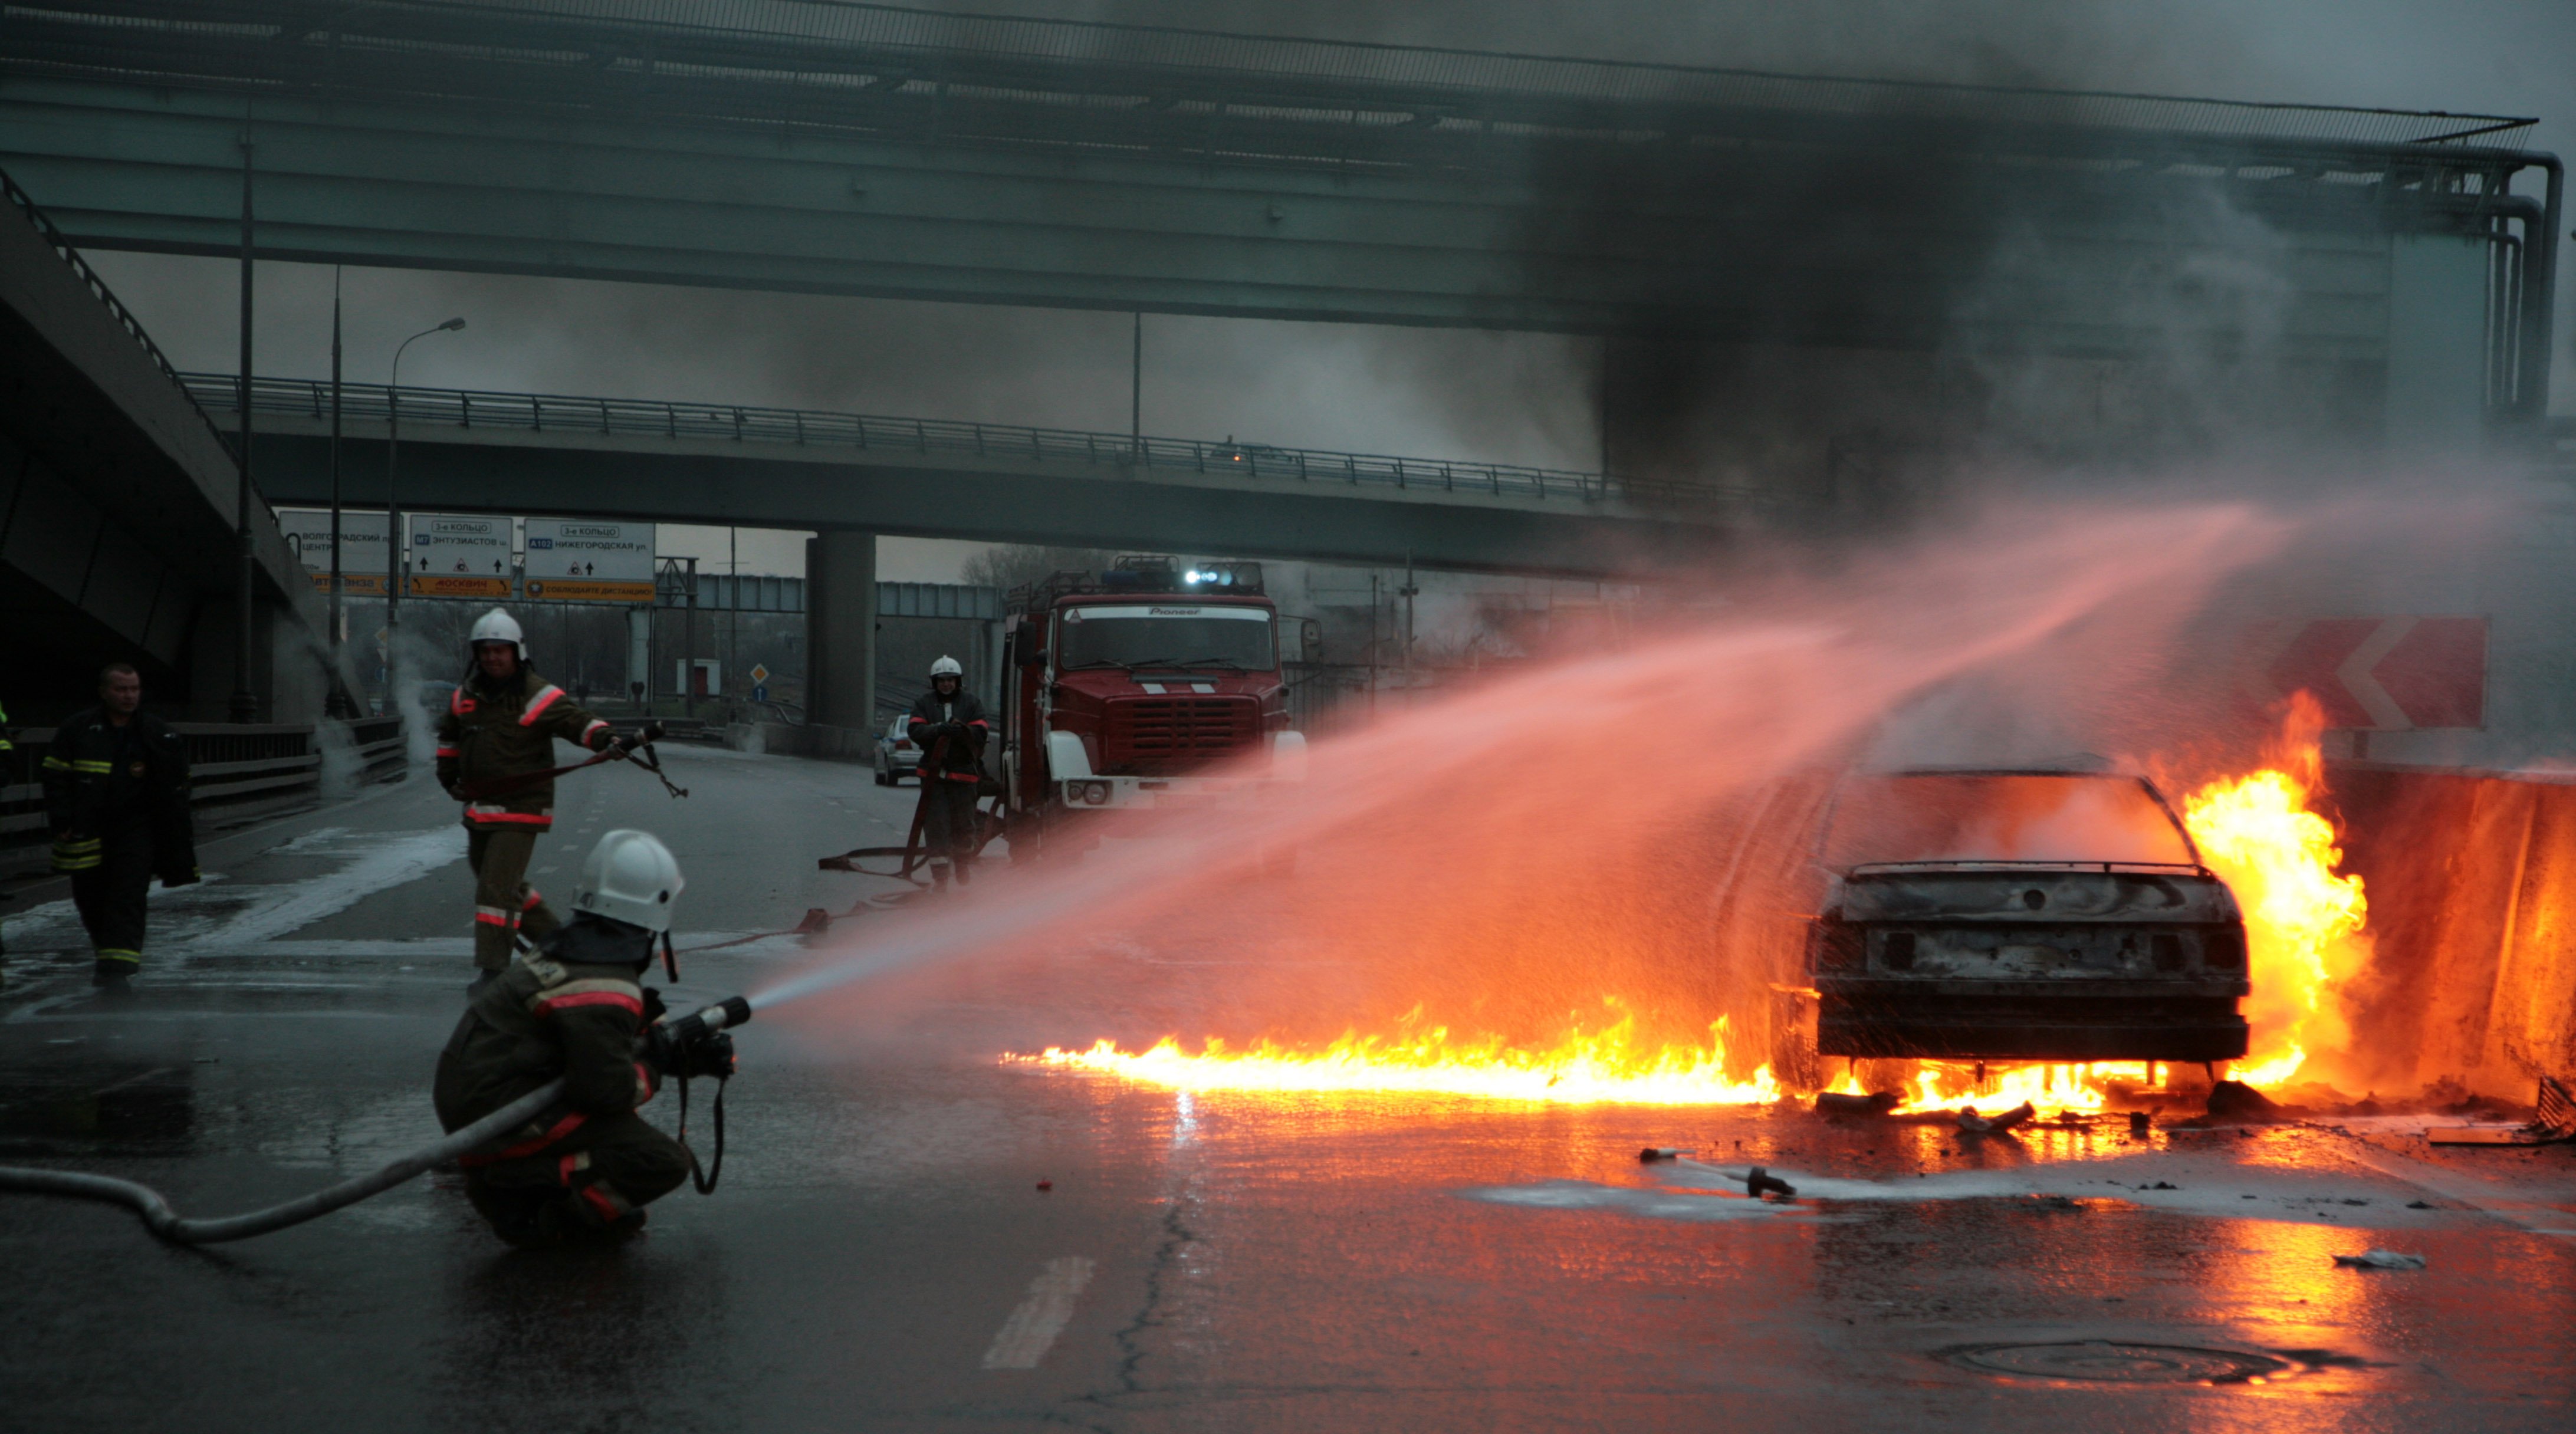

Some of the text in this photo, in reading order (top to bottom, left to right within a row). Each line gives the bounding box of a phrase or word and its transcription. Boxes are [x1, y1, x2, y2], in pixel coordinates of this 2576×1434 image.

[451, 524, 488, 532] КОЛЬЦО
[579, 528, 616, 537] КОЛЬЦО
[302, 532, 380, 542] ВОЛГОРАДСКИЙ
[432, 537, 497, 545] ЭНТУЗИАСТОВ
[555, 541, 633, 550] НИЖЕГОРОДСКАЯ
[546, 585, 599, 594] СОБЛЮДАЙТЕ
